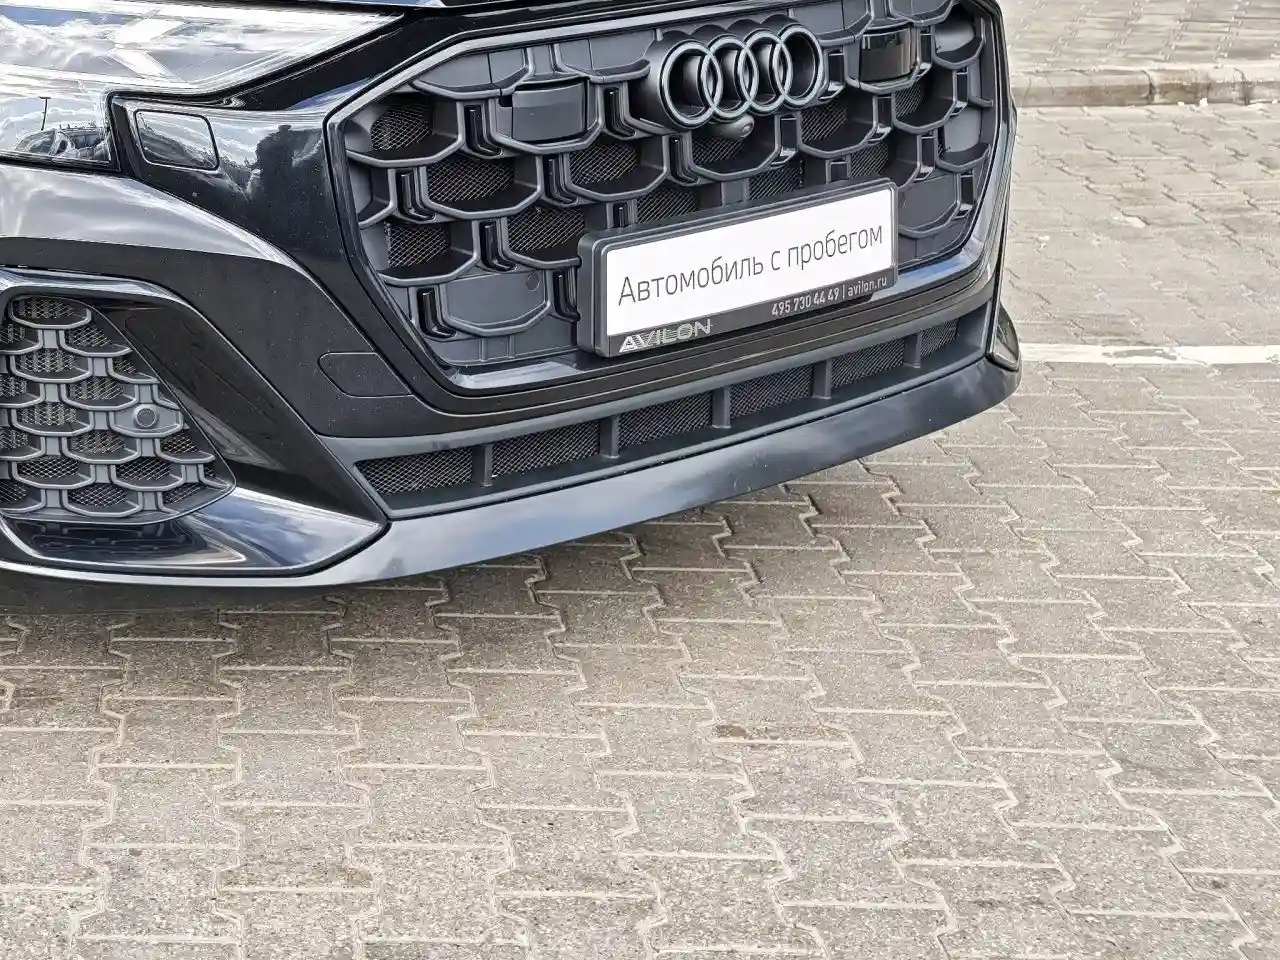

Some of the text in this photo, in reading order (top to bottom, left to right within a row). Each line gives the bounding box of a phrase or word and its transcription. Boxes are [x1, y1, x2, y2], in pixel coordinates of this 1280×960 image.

[618, 225, 883, 306] Автомобиль с пробегом
[771, 300, 791, 317] 495
[793, 294, 811, 312] 730
[813, 290, 826, 305] 44
[827, 287, 840, 301] 49
[847, 276, 888, 297] avilon.ru
[619, 318, 711, 353] AVILON
